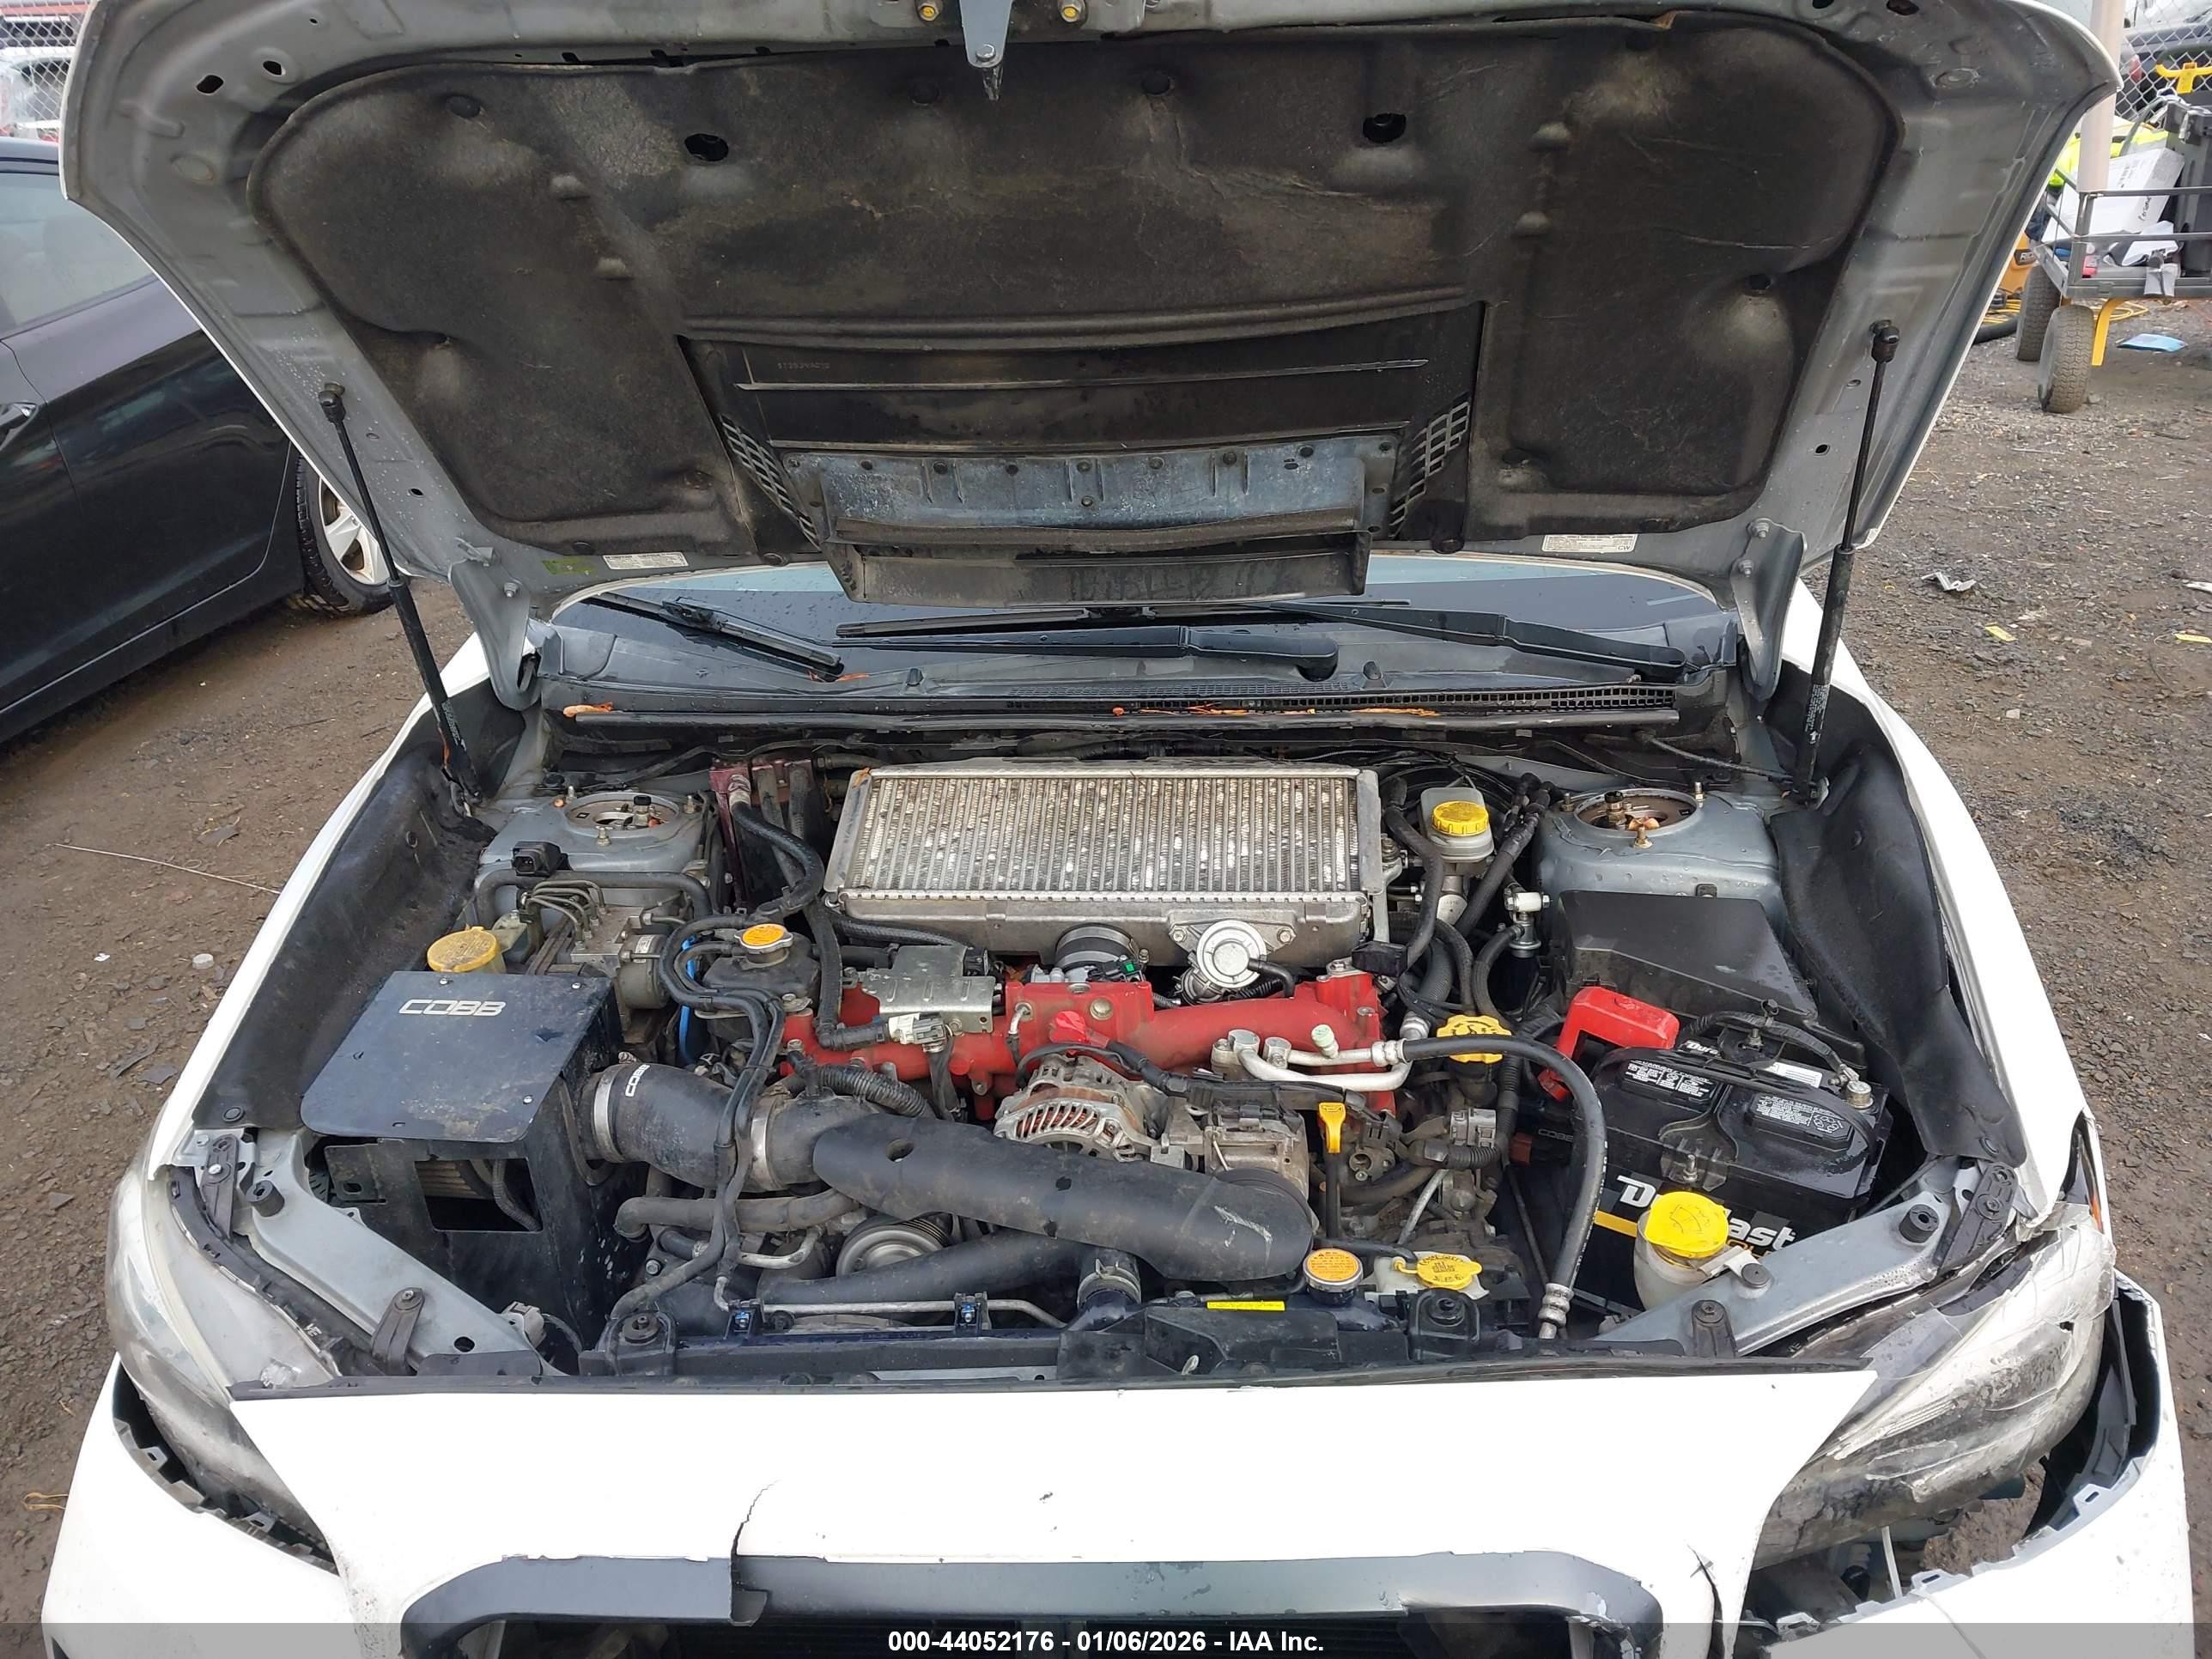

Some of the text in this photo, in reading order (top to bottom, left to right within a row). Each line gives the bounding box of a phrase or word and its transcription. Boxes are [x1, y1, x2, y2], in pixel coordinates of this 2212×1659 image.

[398, 999, 507, 1017] COBB
[1685, 1039, 1720, 1057] Dura
[624, 1064, 651, 1097] COBB
[1617, 1174, 1796, 1250] Dast
